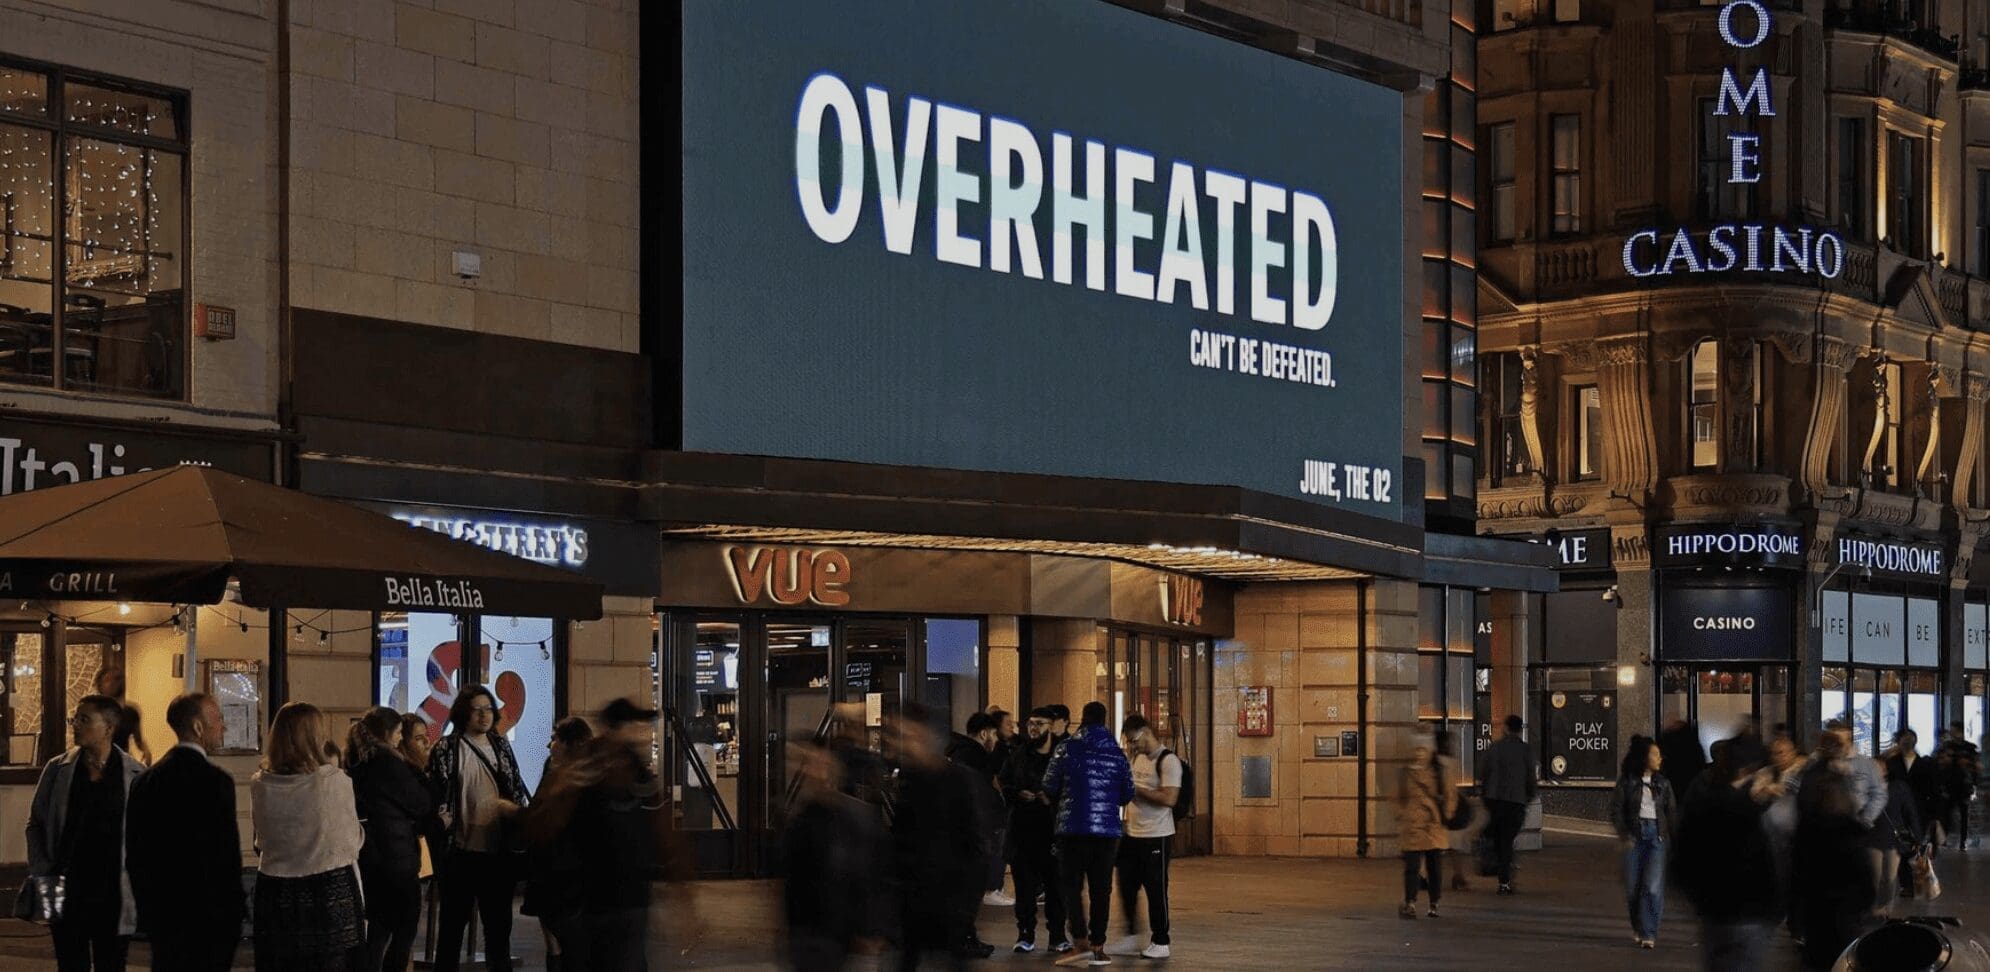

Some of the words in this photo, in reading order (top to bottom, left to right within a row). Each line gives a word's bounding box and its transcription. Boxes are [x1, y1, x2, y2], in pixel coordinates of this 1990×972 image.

[797, 73, 1338, 332] OVERHEATED
[1622, 225, 1842, 279] CASINO
[1190, 328, 1236, 371] CAN'T
[1239, 337, 1258, 375] BE
[1261, 341, 1336, 388] DEFEATED.
[0, 437, 152, 496] Itali
[1300, 459, 1341, 502] JUNE,
[1344, 464, 1370, 500] THE
[1668, 533, 1799, 556] HIPPODROME
[1838, 538, 1941, 575] HIPPODROME
[49, 572, 118, 593] GRILL
[385, 577, 434, 606] Bella
[436, 579, 484, 609] Italia
[1477, 621, 1493, 635] AS
[1693, 616, 1755, 630] CASINO
[1825, 617, 1844, 636] IFE
[1865, 620, 1890, 640] CAN
[1916, 623, 1930, 641] BE
[1575, 722, 1603, 735] PLAY
[1569, 738, 1609, 750] POKER
